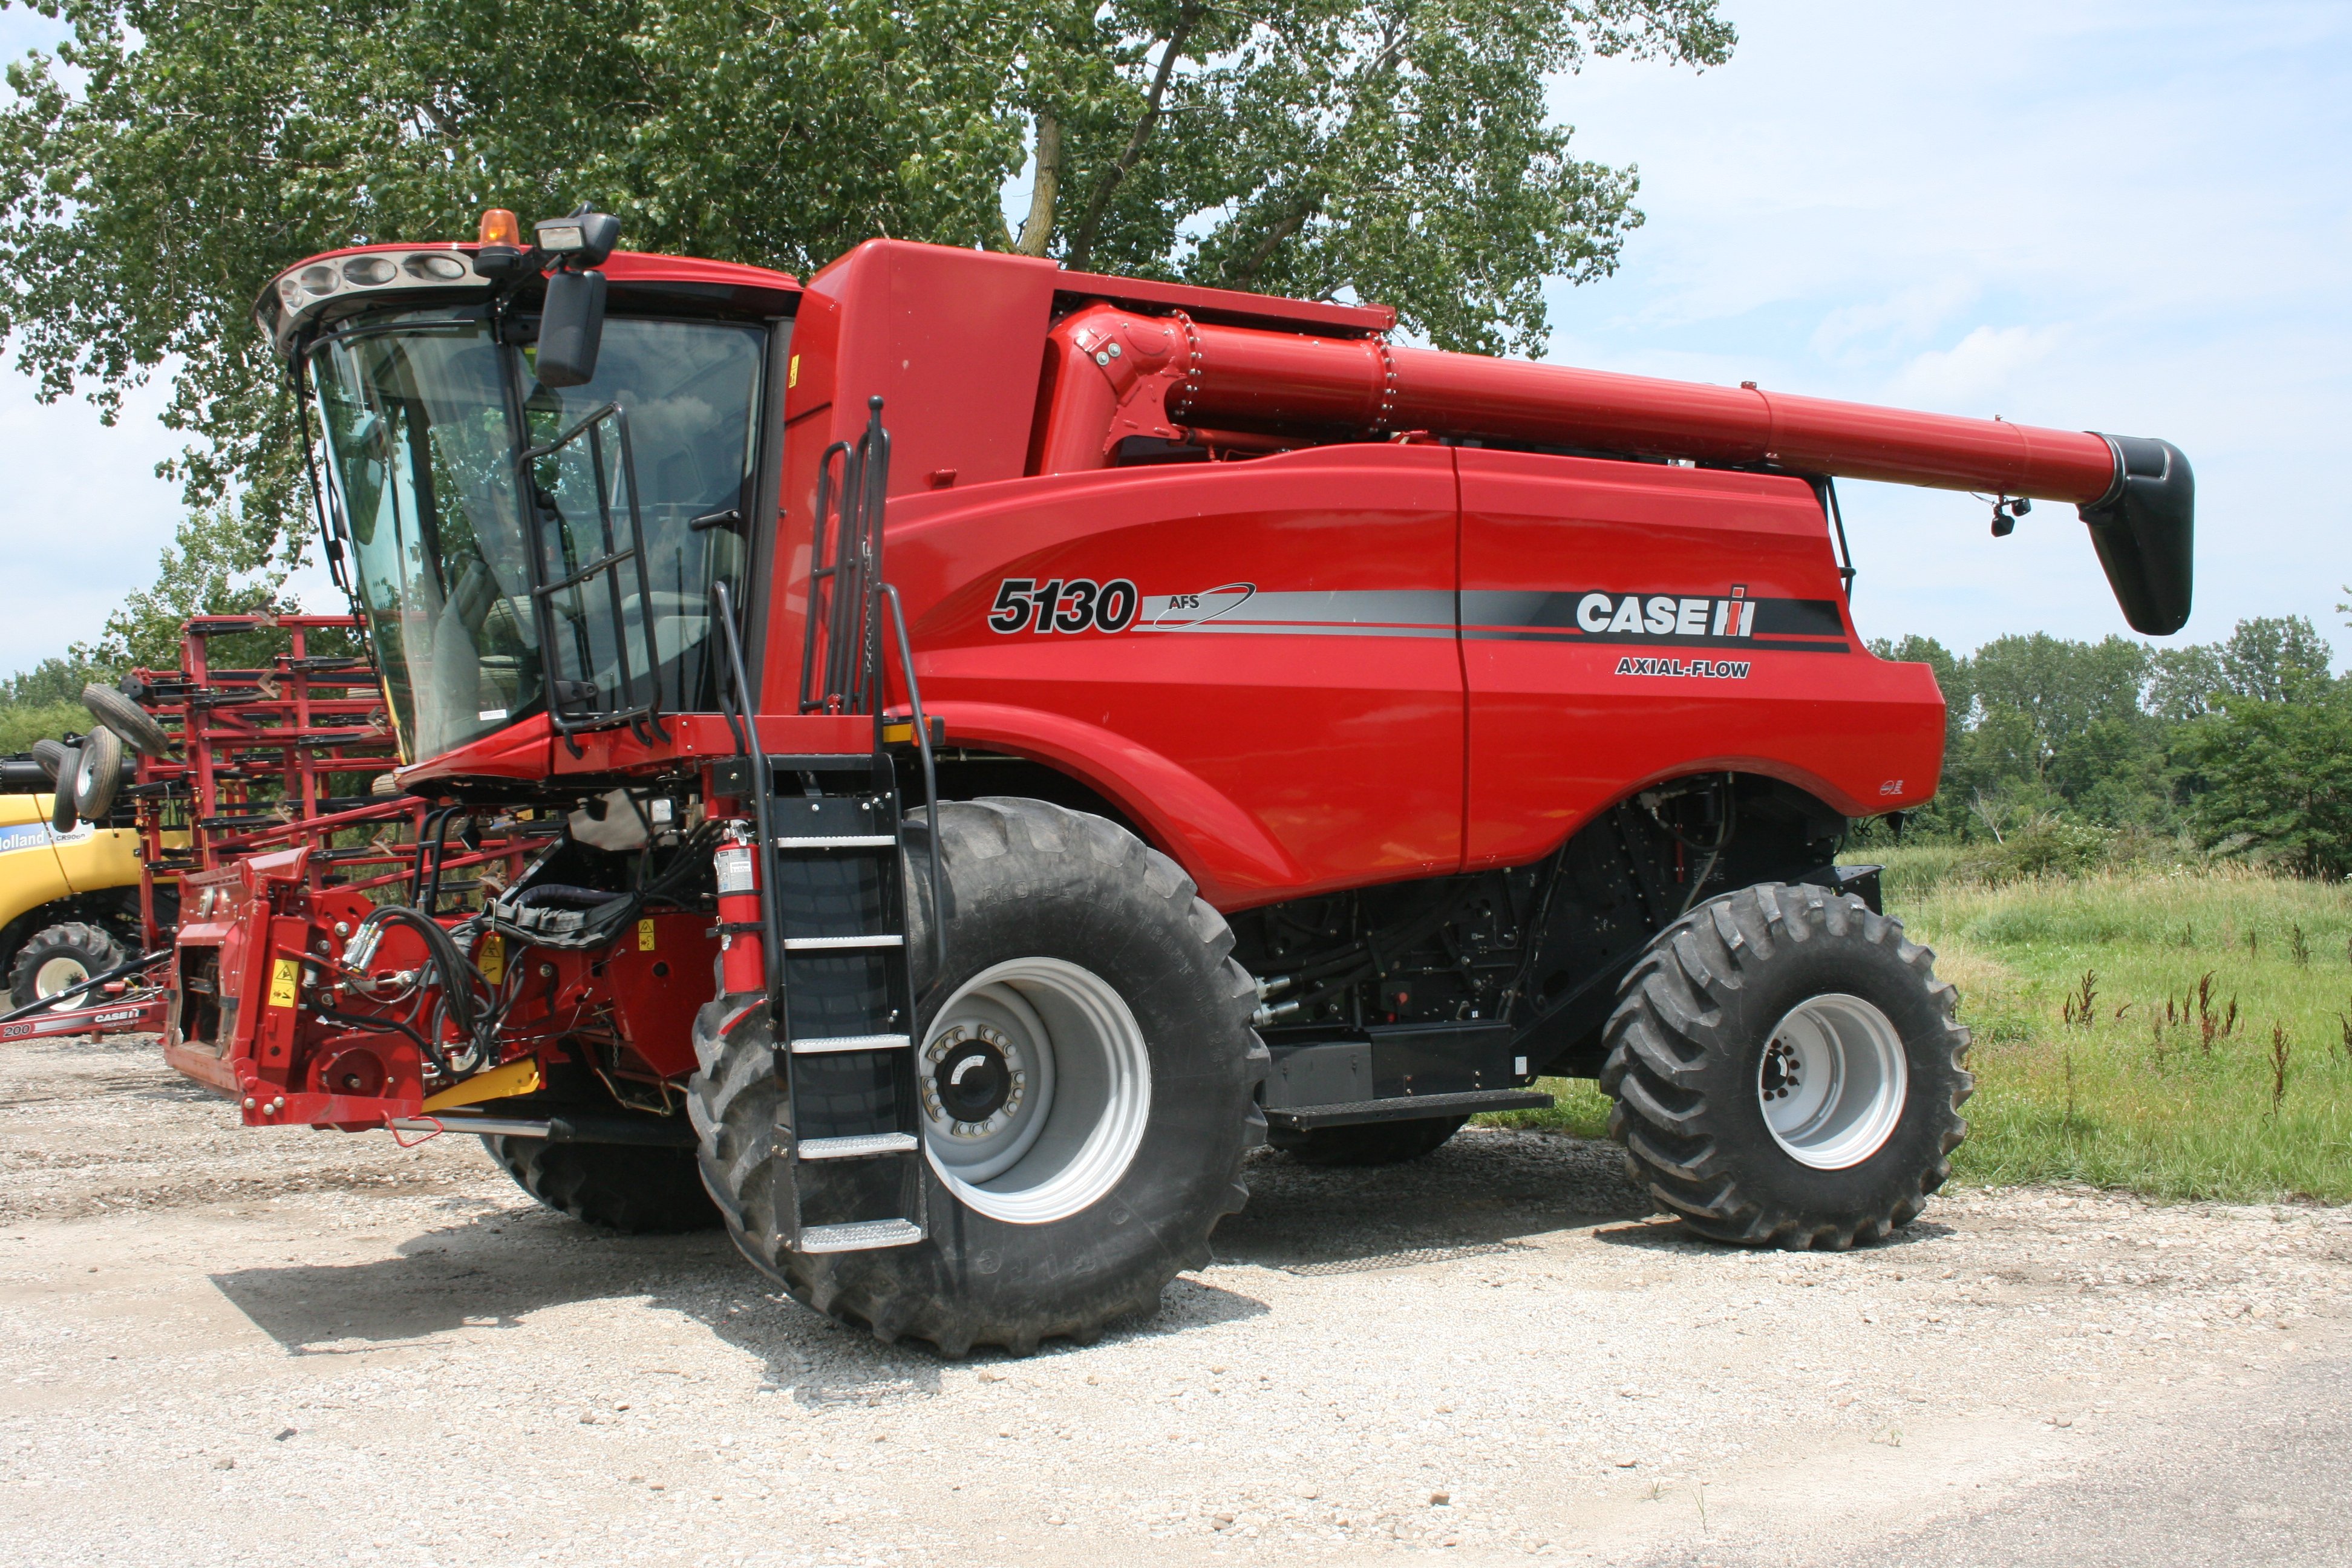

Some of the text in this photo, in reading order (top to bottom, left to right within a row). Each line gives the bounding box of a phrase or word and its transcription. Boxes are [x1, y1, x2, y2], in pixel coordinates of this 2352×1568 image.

[987, 578, 1138, 634] 5130
[1168, 594, 1200, 610] AFS
[1615, 657, 1751, 679] AXIAL-FLOW
[3, 1024, 31, 1037] 200
